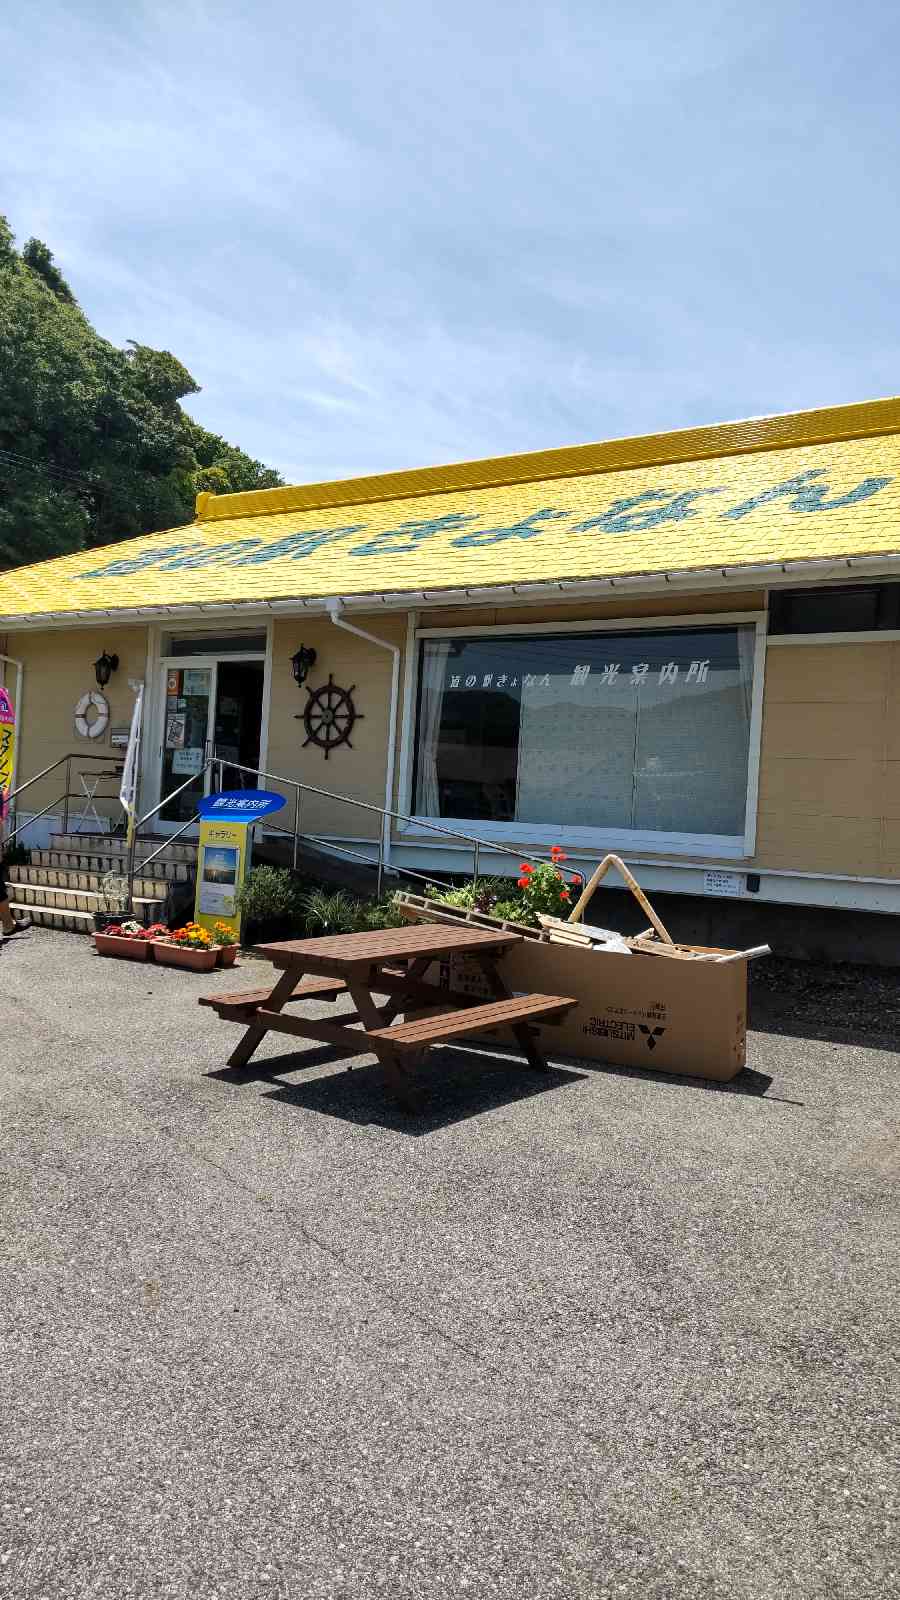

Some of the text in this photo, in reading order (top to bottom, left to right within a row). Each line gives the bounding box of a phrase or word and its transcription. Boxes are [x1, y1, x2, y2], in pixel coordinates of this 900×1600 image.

[569, 660, 710, 686] 観光案内所
[211, 797, 273, 810] 観光案内所
[590, 1016, 635, 1032] ELECTRIC
